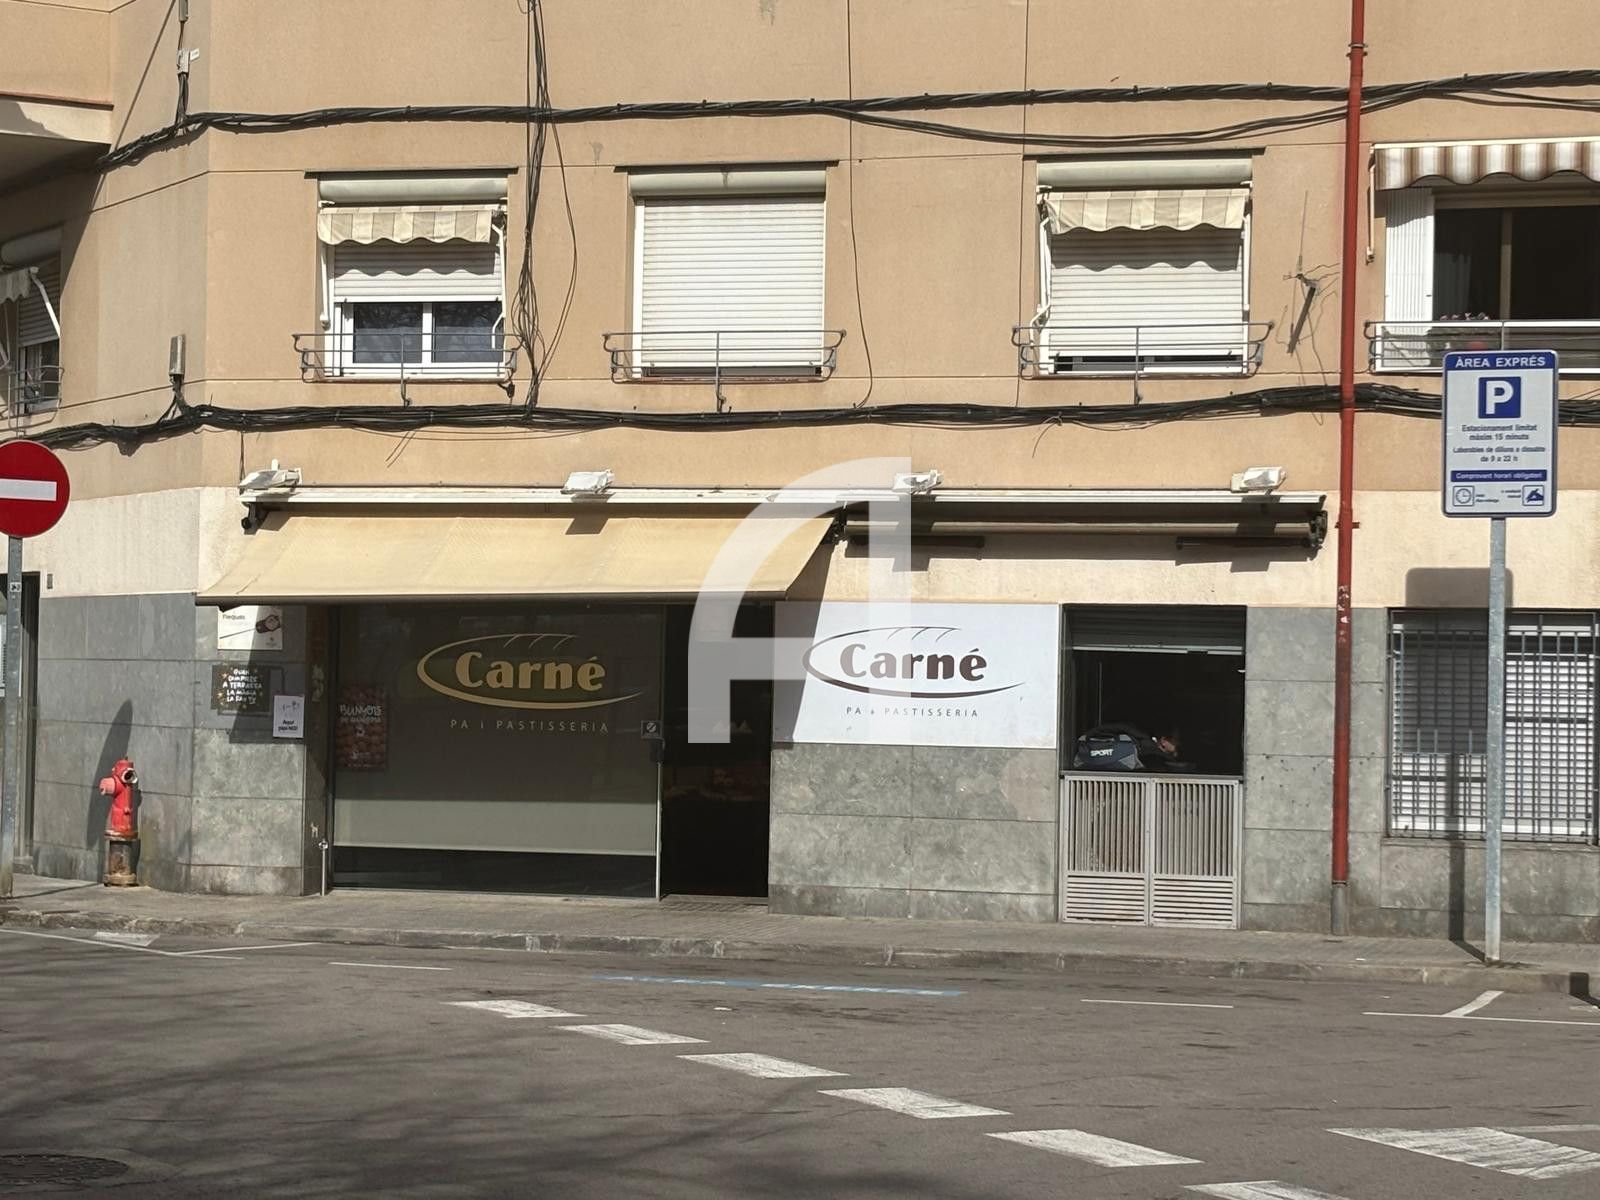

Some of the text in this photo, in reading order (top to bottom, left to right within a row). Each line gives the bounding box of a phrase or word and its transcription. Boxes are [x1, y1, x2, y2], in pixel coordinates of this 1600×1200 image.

[1456, 355, 1546, 368] ÀREA EXPRÉS
[1486, 381, 1513, 414] P
[1461, 423, 1537, 432] Estacionament limitat
[840, 643, 987, 682] Carné
[455, 651, 606, 692] Carné
[846, 707, 862, 715] PA
[884, 707, 978, 718] PASTISSERIA
[450, 719, 469, 729] PA
[496, 720, 609, 733] PASTISSERIA
[1090, 748, 1114, 757] SPORT
